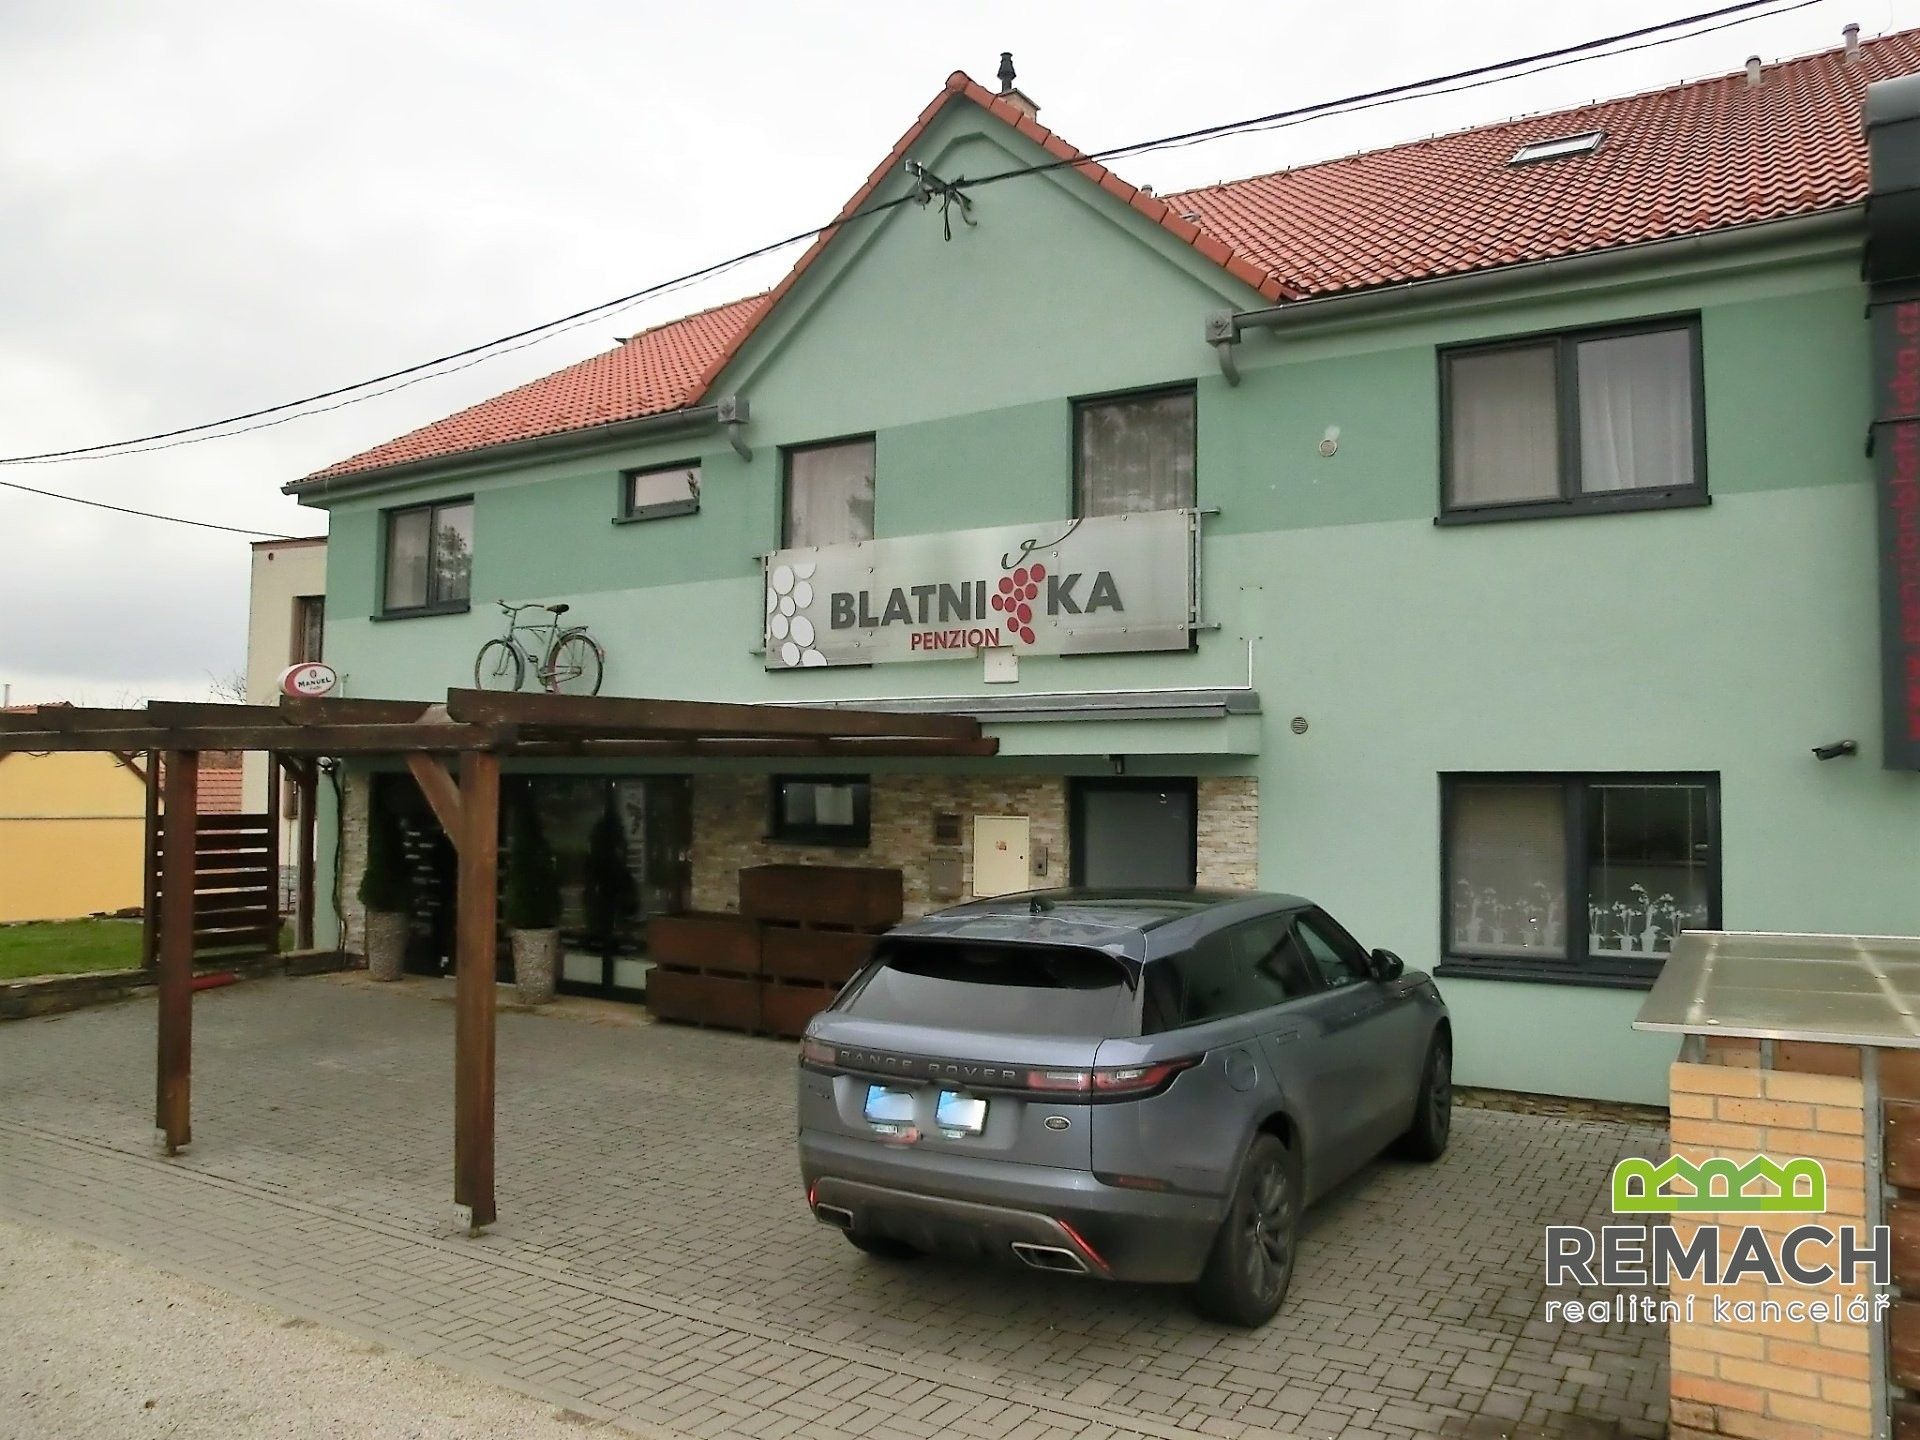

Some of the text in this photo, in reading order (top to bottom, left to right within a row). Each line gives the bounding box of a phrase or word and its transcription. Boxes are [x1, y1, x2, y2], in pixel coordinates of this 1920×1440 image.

[911, 627, 1000, 651] PENZION
[297, 676, 332, 688] MANUEL
[839, 1050, 1016, 1080] RANGE ROVER
